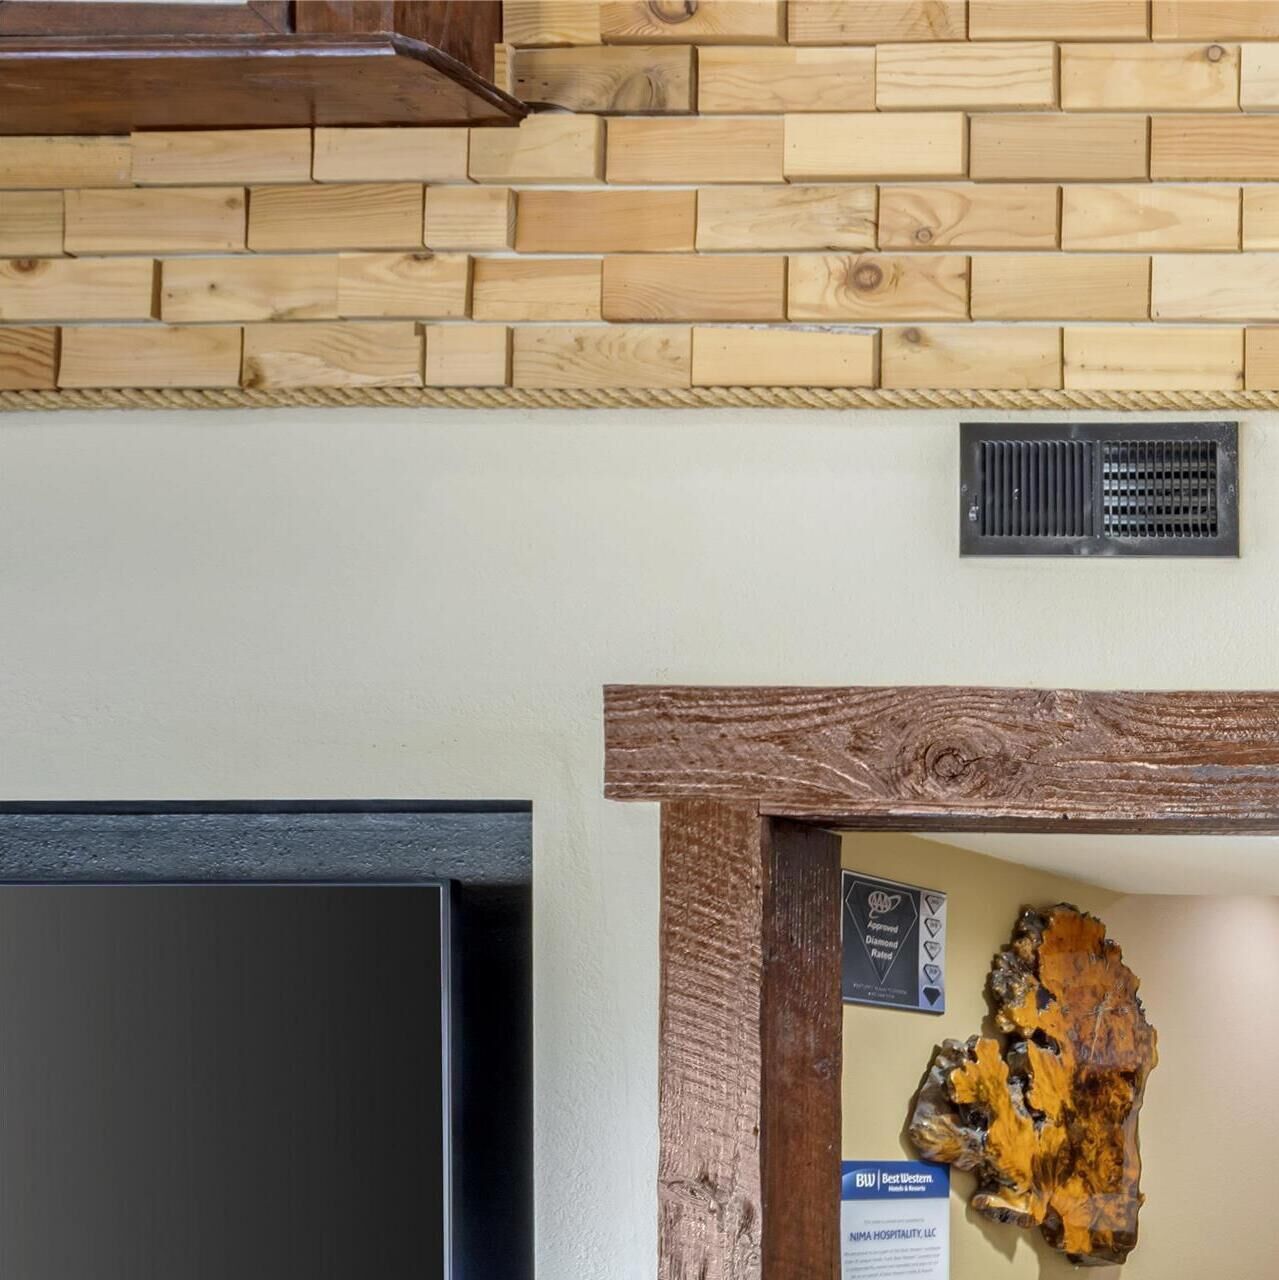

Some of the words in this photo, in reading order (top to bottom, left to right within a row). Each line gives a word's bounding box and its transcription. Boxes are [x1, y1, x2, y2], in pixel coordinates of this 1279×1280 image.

[867, 920, 899, 934] Approved
[865, 935, 899, 949] Diamond
[871, 948, 893, 960] Rated
[856, 1173, 876, 1188] BW
[882, 1174, 900, 1184] Best
[849, 1231, 872, 1242] NIMA
[874, 1229, 922, 1240] HOSPITALITY,
[924, 1228, 937, 1238] LLC
